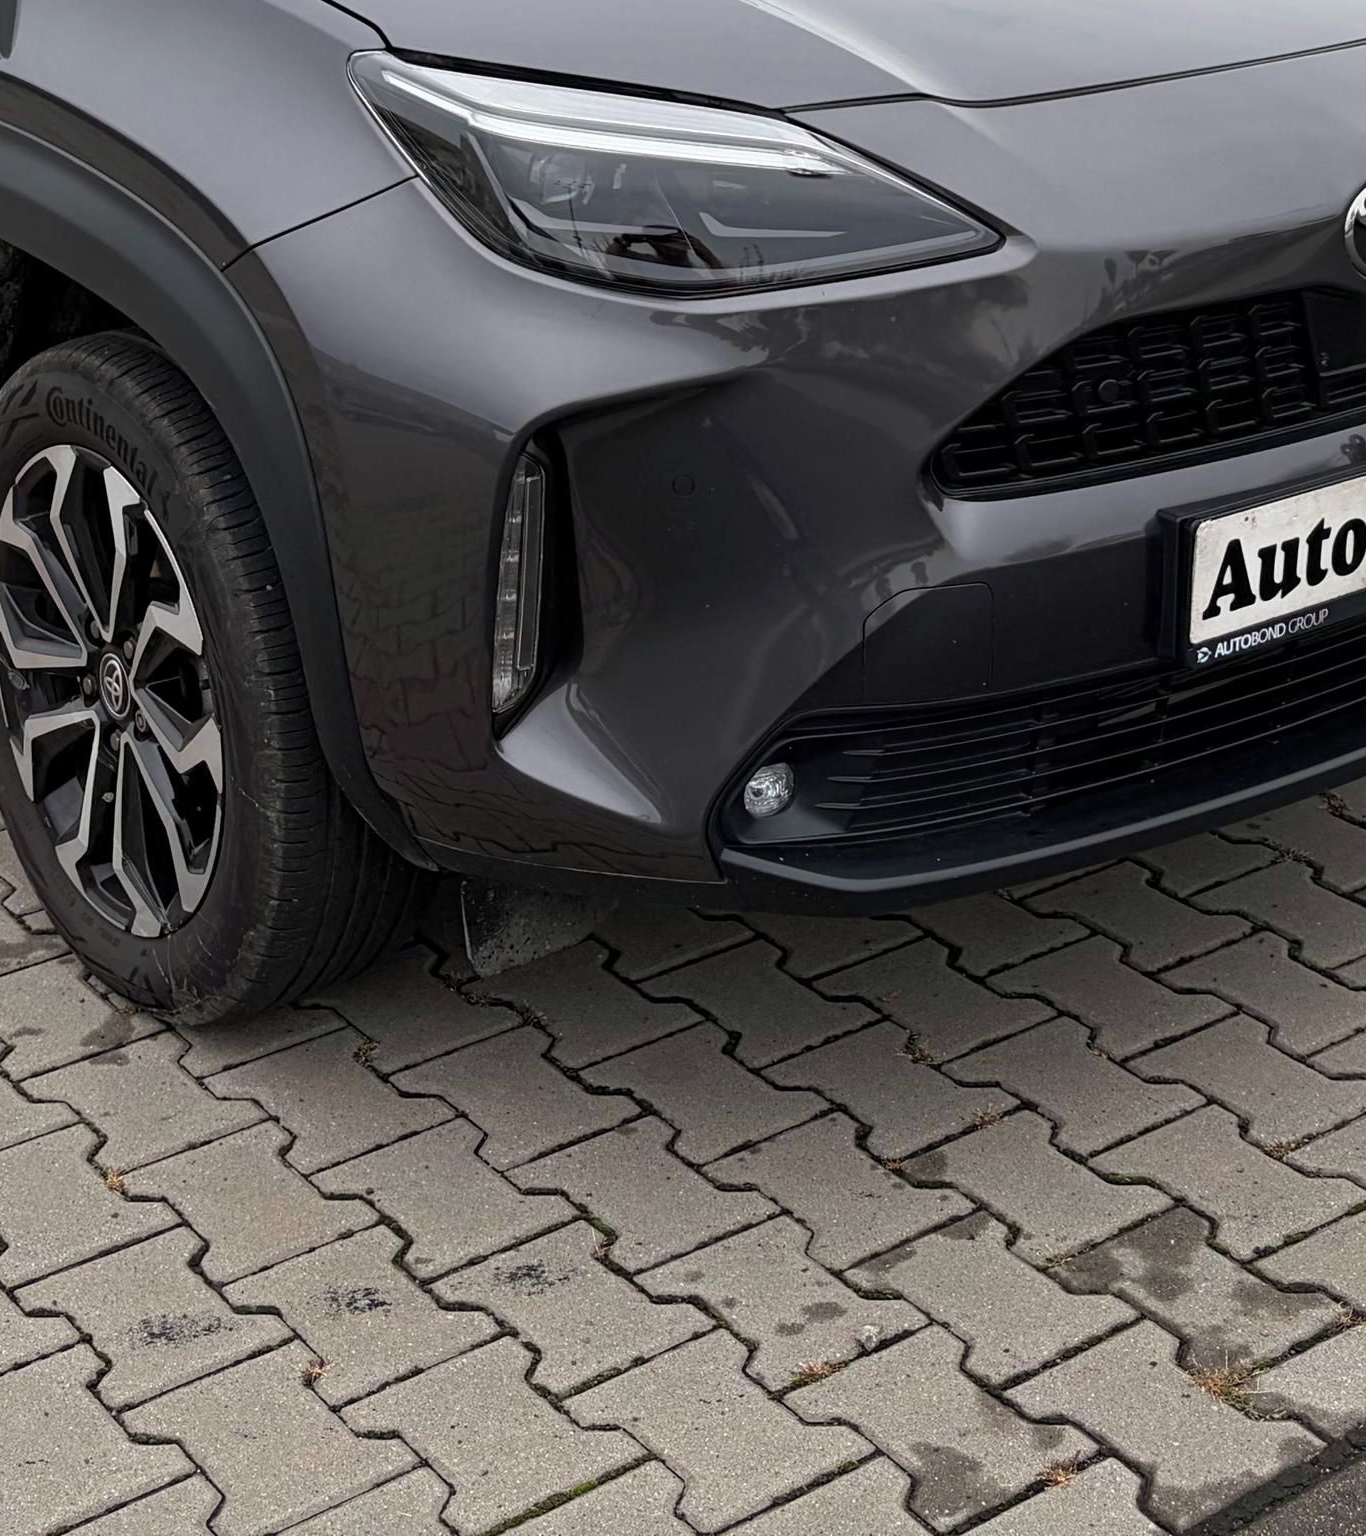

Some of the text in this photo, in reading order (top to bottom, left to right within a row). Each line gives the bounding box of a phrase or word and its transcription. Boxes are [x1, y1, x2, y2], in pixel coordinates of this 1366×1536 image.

[45, 386, 159, 498] Continental
[1214, 608, 1329, 659] AUTOBOND GROUP
